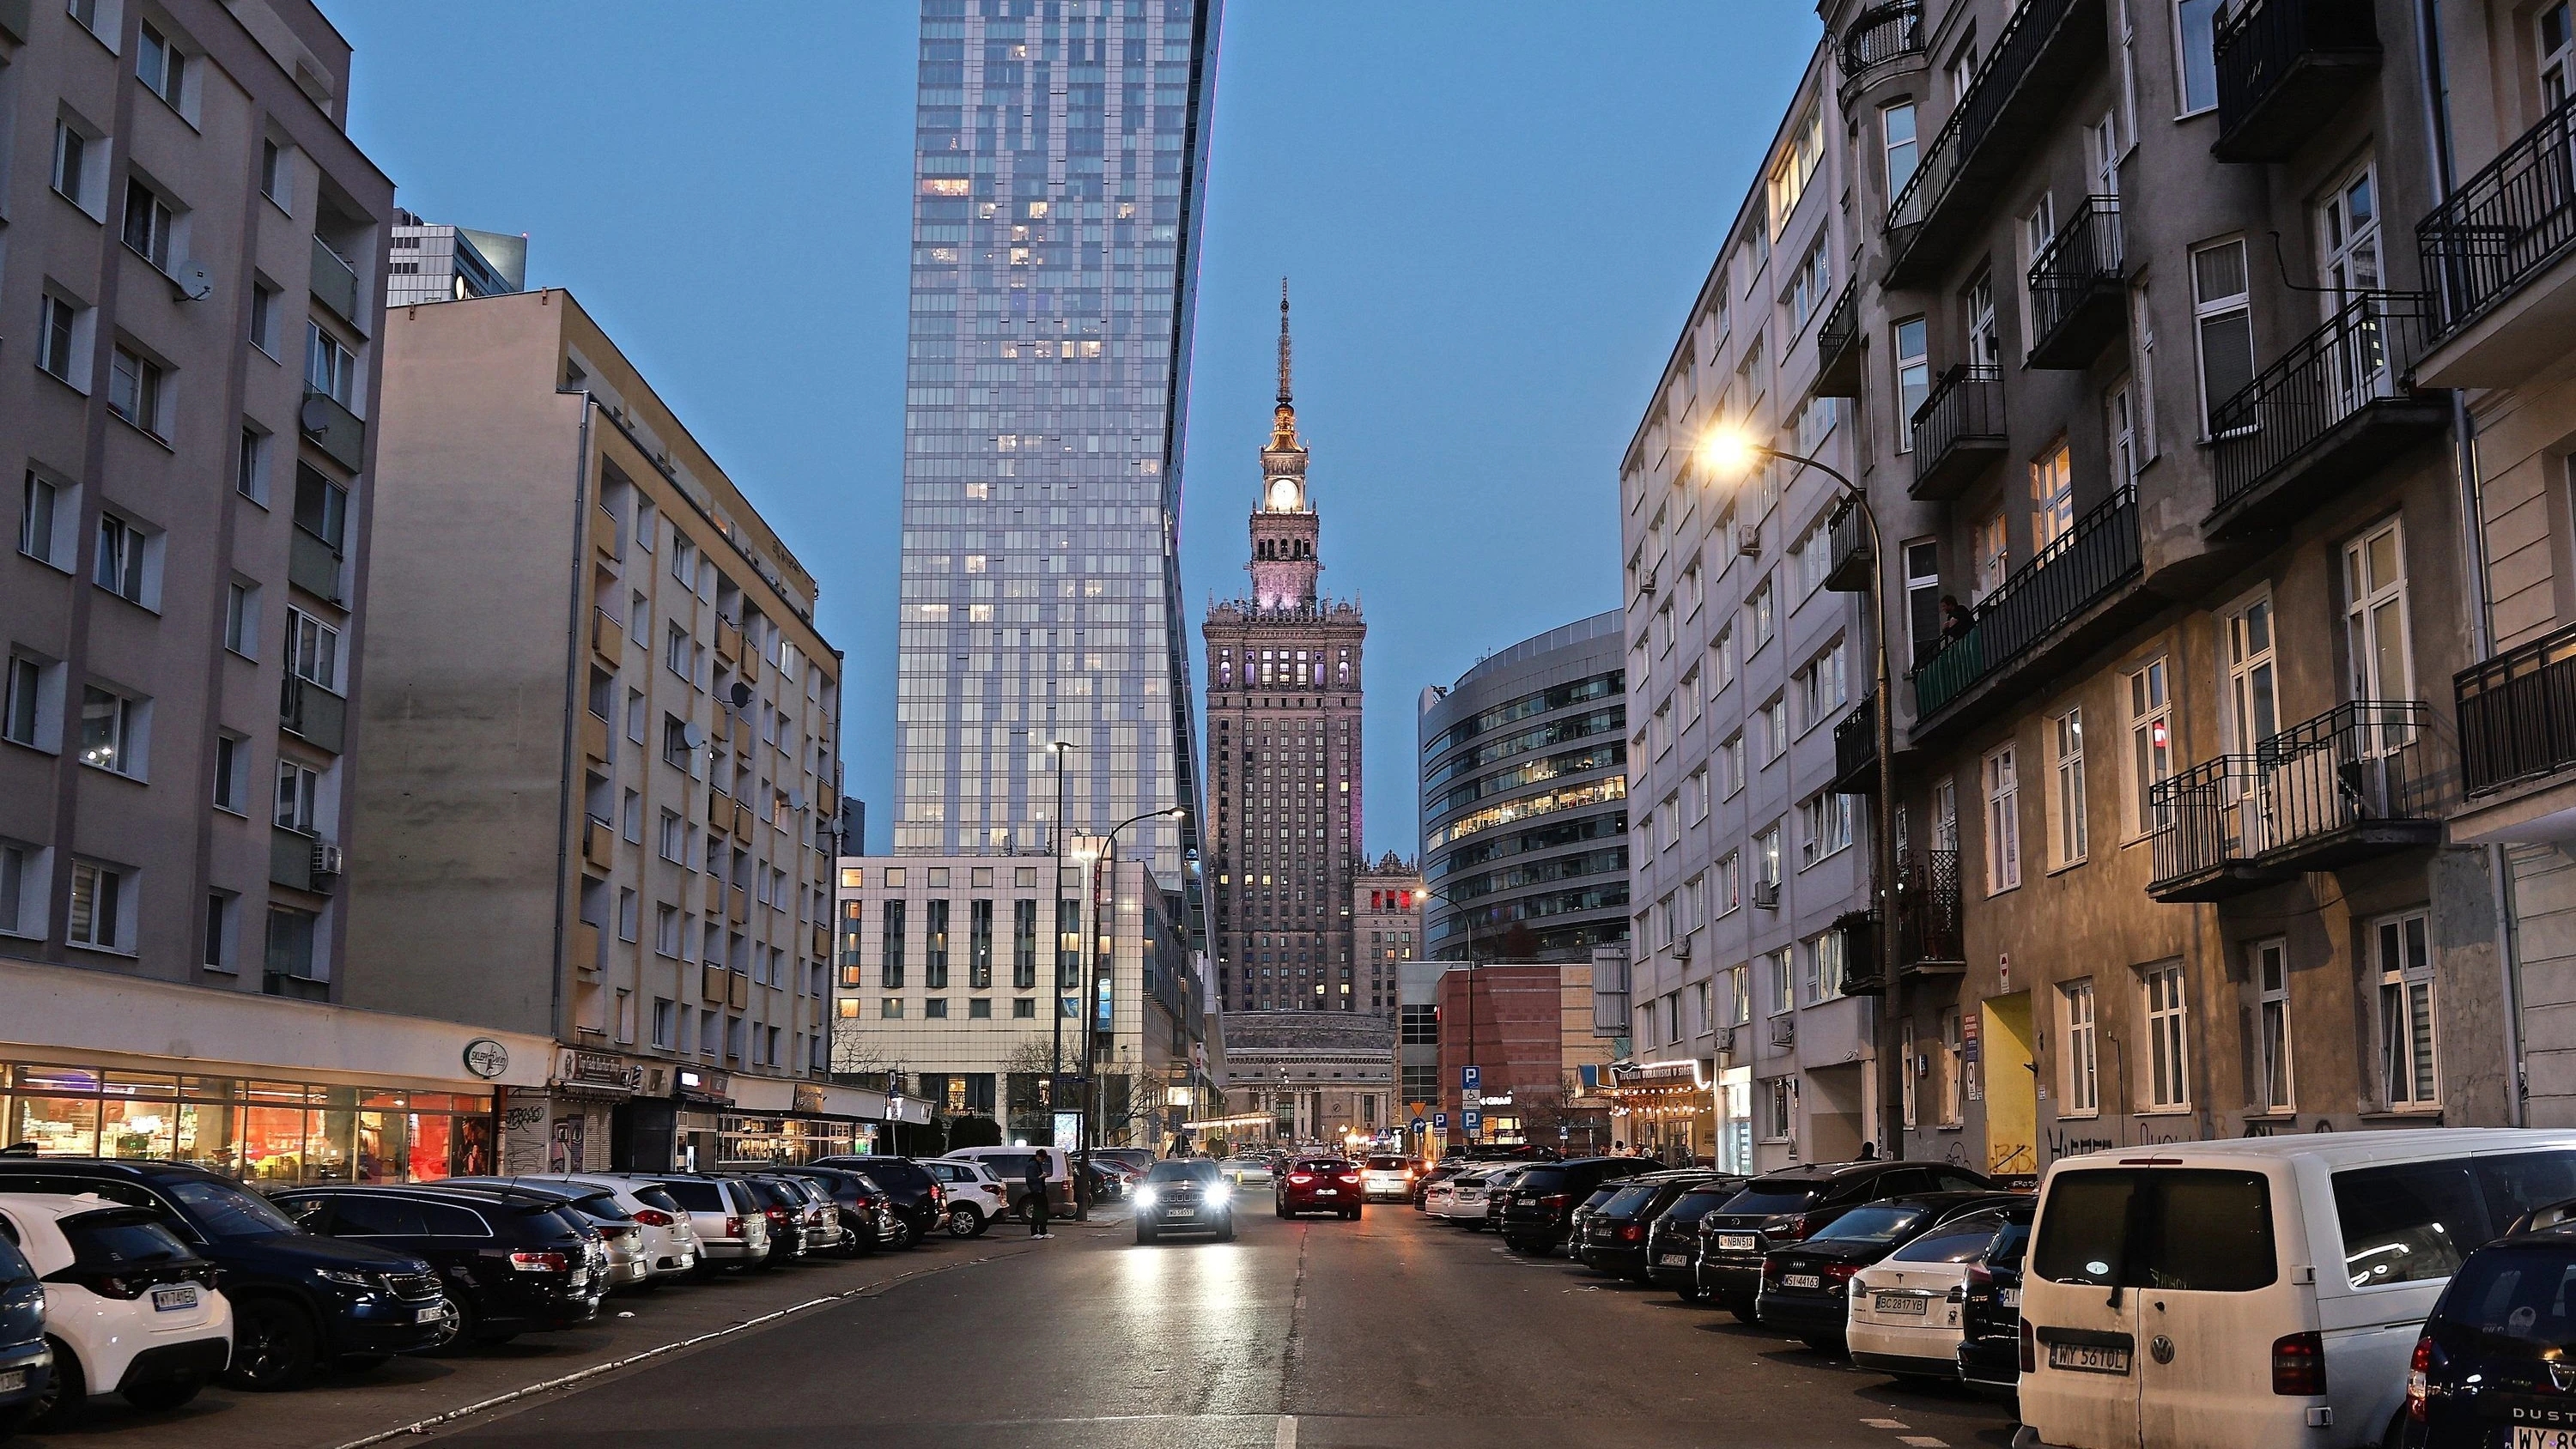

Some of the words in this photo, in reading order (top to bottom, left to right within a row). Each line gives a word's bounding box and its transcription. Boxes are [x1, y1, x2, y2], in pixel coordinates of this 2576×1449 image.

[1466, 1068, 1477, 1082] P
[1436, 1114, 1444, 1125] P
[1466, 1112, 1477, 1126] P
[1880, 1297, 1892, 1308] BC
[1893, 1298, 1911, 1309] 2817
[1911, 1300, 1923, 1311] YB
[2059, 1346, 2075, 1365] WY
[2518, 1428, 2547, 1449] WY
